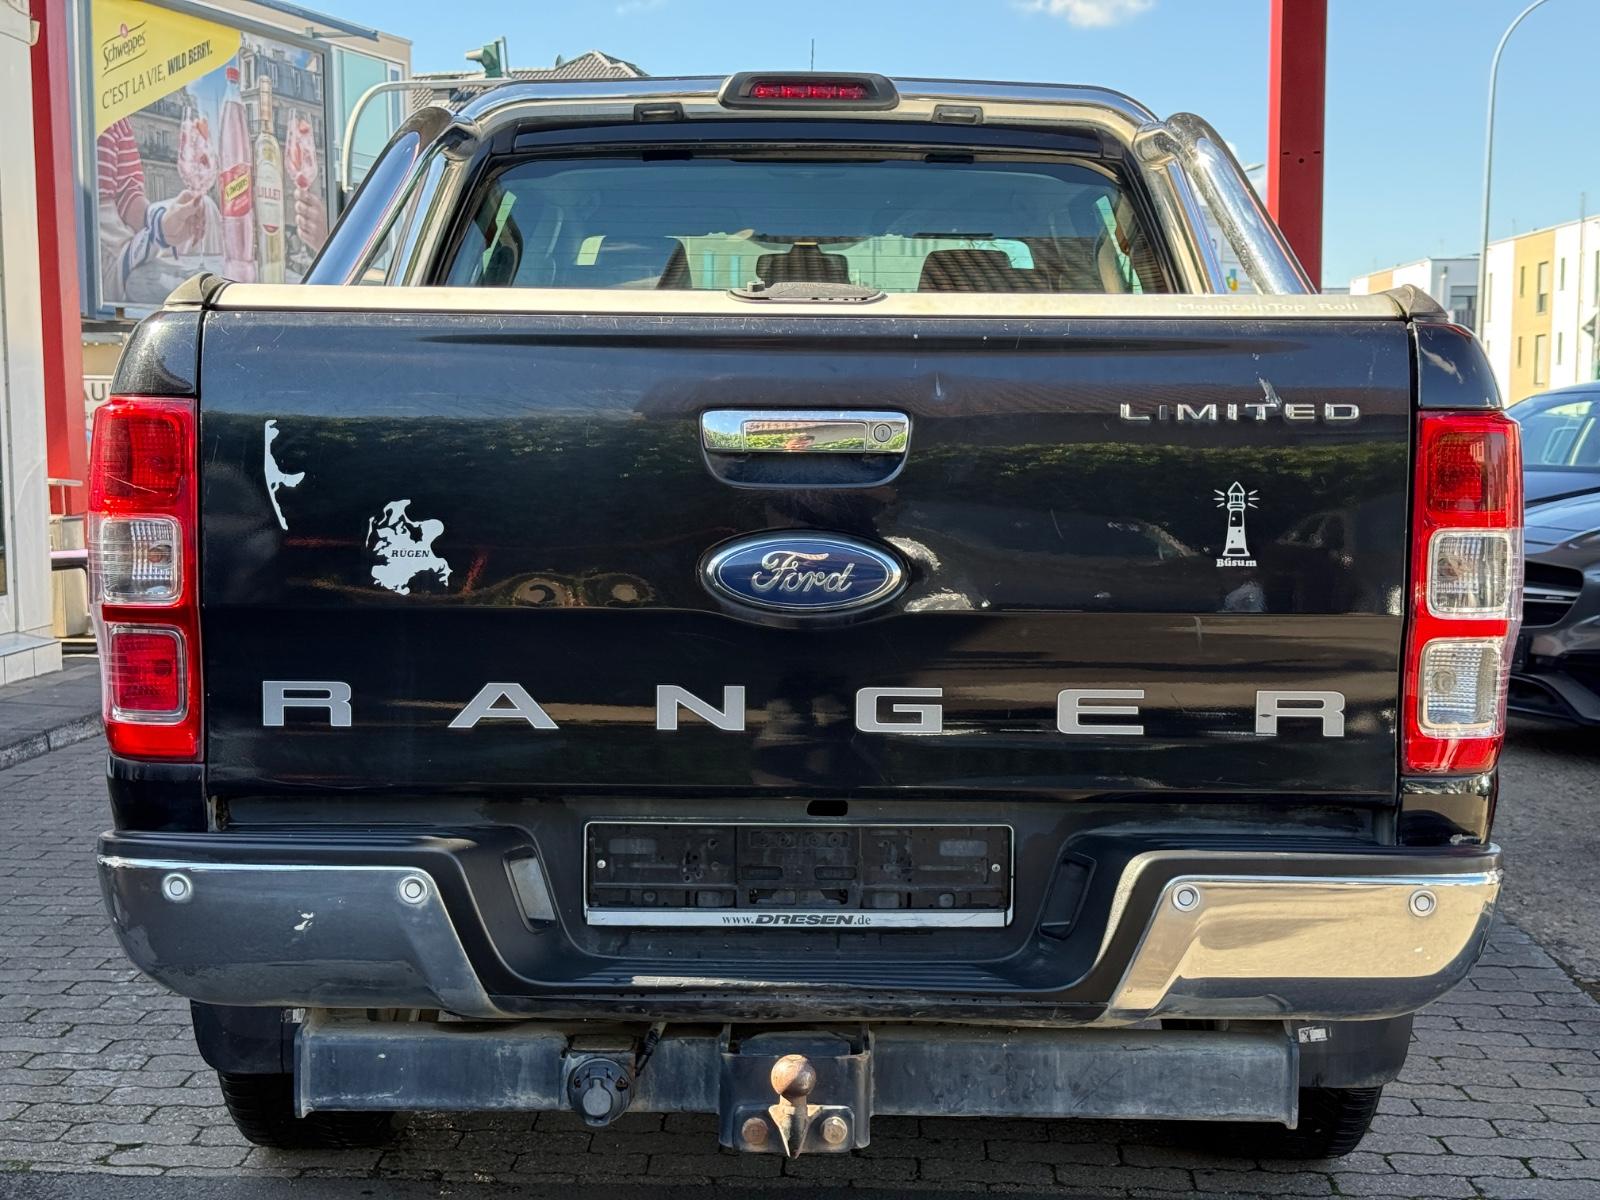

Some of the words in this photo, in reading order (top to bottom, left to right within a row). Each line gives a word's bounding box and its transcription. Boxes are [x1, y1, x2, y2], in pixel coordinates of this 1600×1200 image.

[103, 31, 146, 70] Schweppes
[102, 79, 129, 109] C'EST
[132, 75, 146, 94] LA
[167, 51, 188, 76] WILD
[188, 40, 213, 66] BERRY.
[1318, 303, 1359, 312] Roll
[1120, 403, 1360, 421] LIMITED
[752, 551, 855, 593] Ford
[262, 680, 1346, 737] RANGER
[721, 913, 872, 926] www.DRESEN.de
